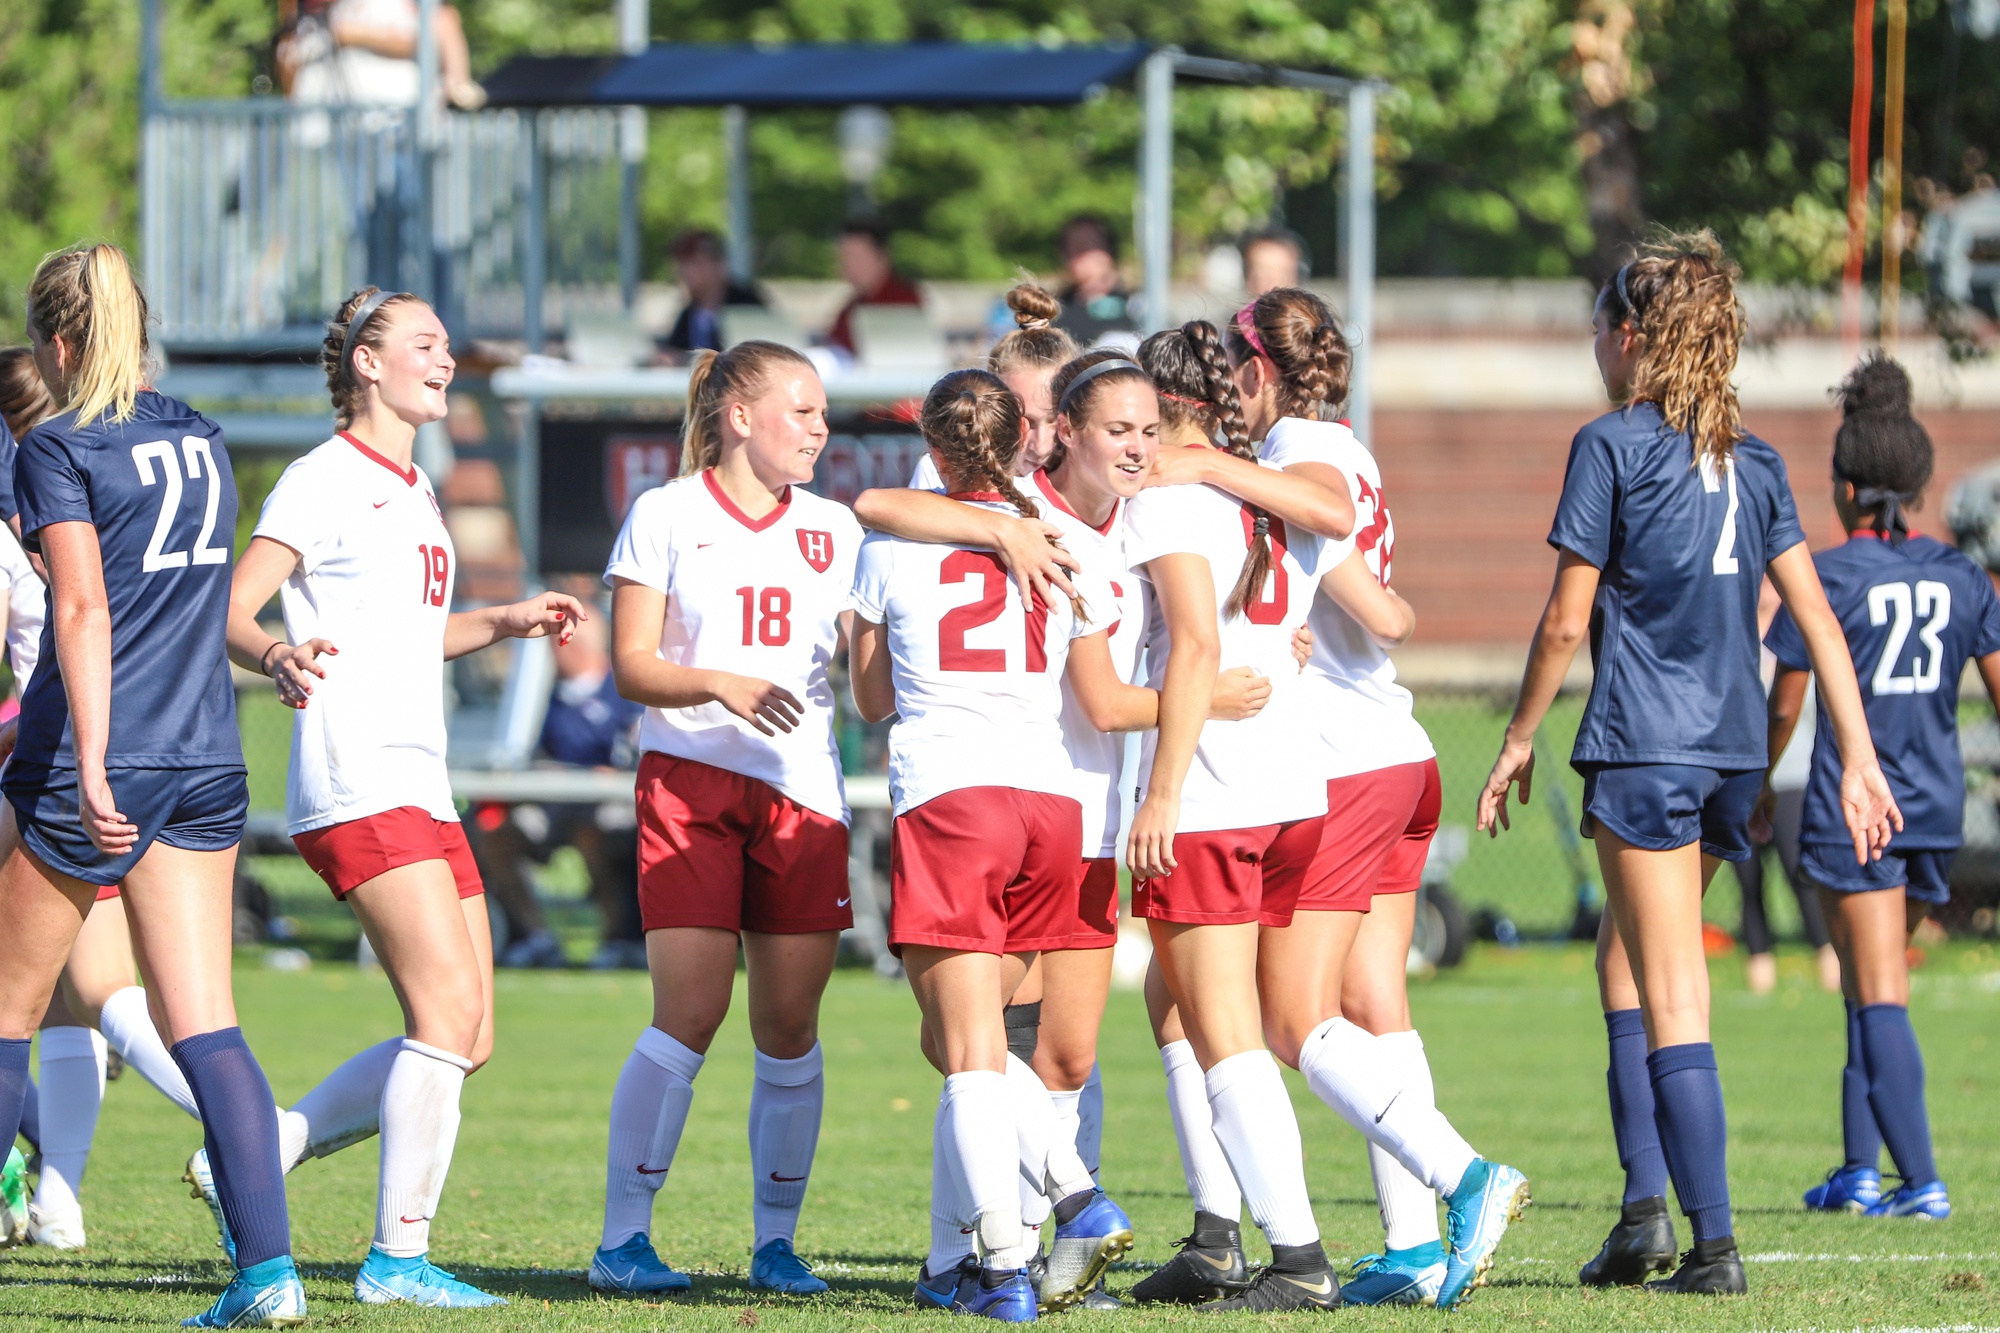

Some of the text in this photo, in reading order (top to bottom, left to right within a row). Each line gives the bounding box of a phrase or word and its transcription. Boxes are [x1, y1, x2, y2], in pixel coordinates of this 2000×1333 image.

[131, 435, 228, 573] 22
[805, 532, 827, 562] H
[418, 543, 449, 607] 19
[736, 586, 791, 646] 18
[939, 549, 1048, 673] 21
[1867, 580, 1951, 696] 23
